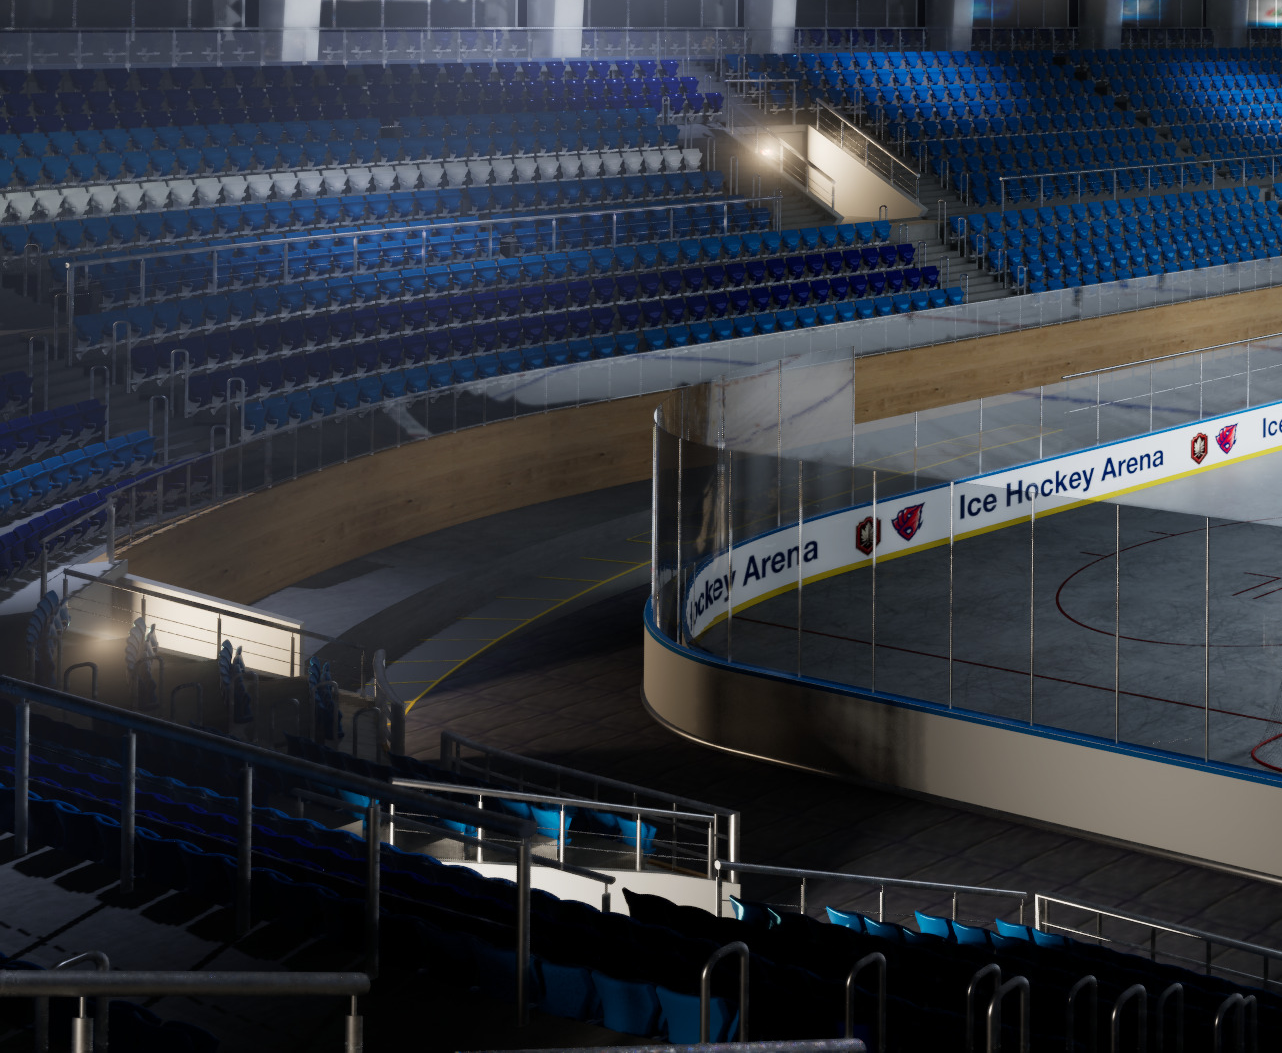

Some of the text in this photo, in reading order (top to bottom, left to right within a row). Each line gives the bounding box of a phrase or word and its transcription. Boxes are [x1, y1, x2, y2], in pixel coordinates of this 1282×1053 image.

[960, 450, 1164, 519] Ice Hockey Arena
[690, 540, 818, 631] ockey Arena
